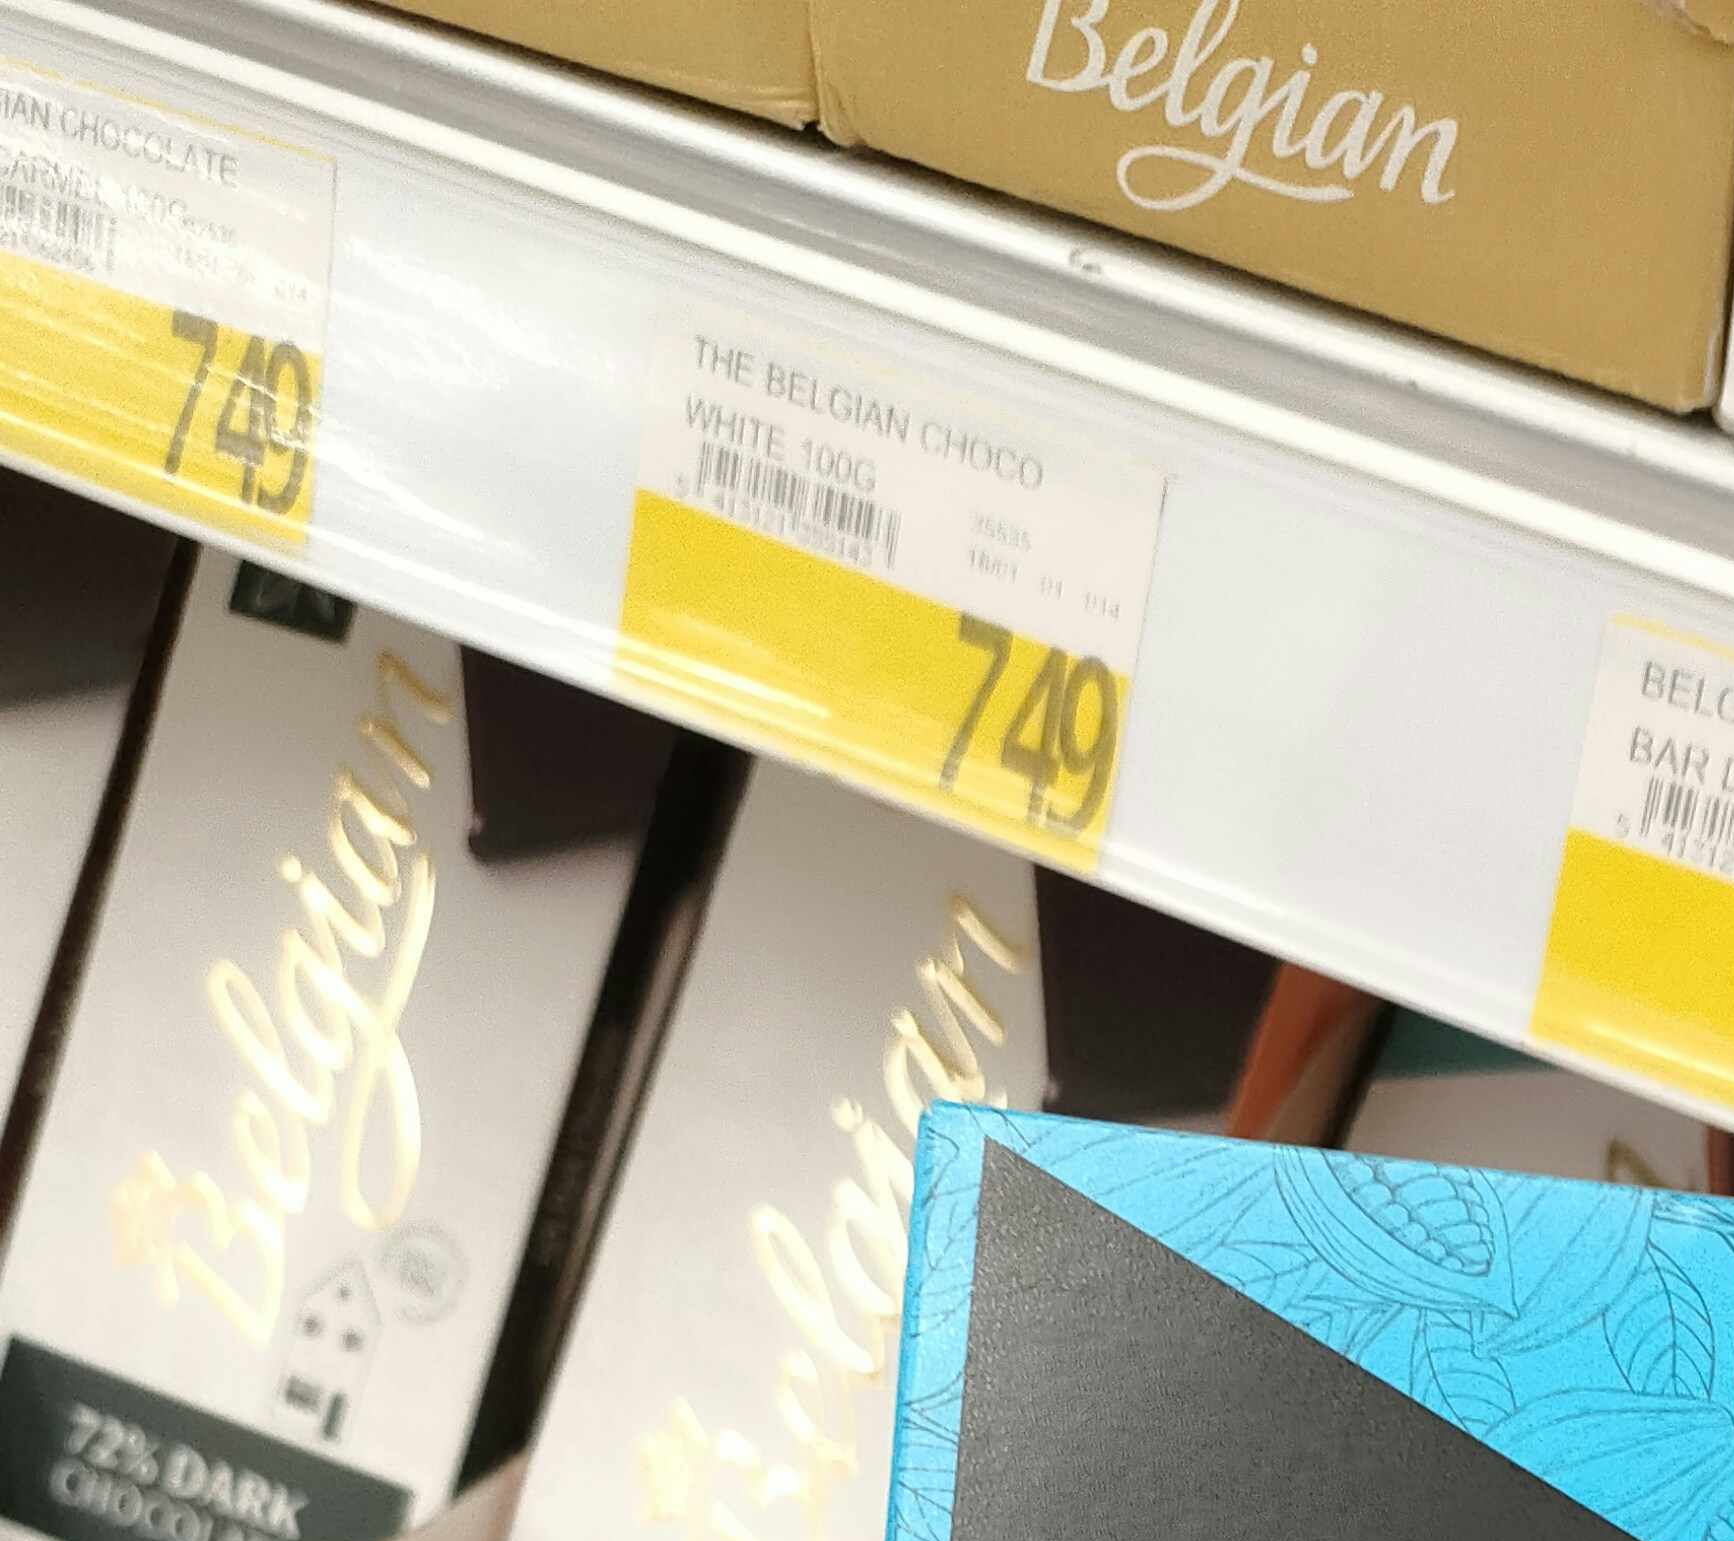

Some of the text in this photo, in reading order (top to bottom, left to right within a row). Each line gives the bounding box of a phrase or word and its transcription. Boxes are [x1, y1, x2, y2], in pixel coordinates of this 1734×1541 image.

[59, 106, 239, 188] CHOCOLATE
[1027, 0, 1459, 211] Belgian
[164, 309, 314, 516] 749
[685, 394, 877, 492] WHITE 100G
[693, 334, 1044, 491] THE BELGIAN CHOCO
[938, 609, 1119, 836] 749
[1629, 725, 1710, 785] BAR
[155, 648, 452, 1350] Belgian
[66, 1401, 310, 1541] 72% DARK
